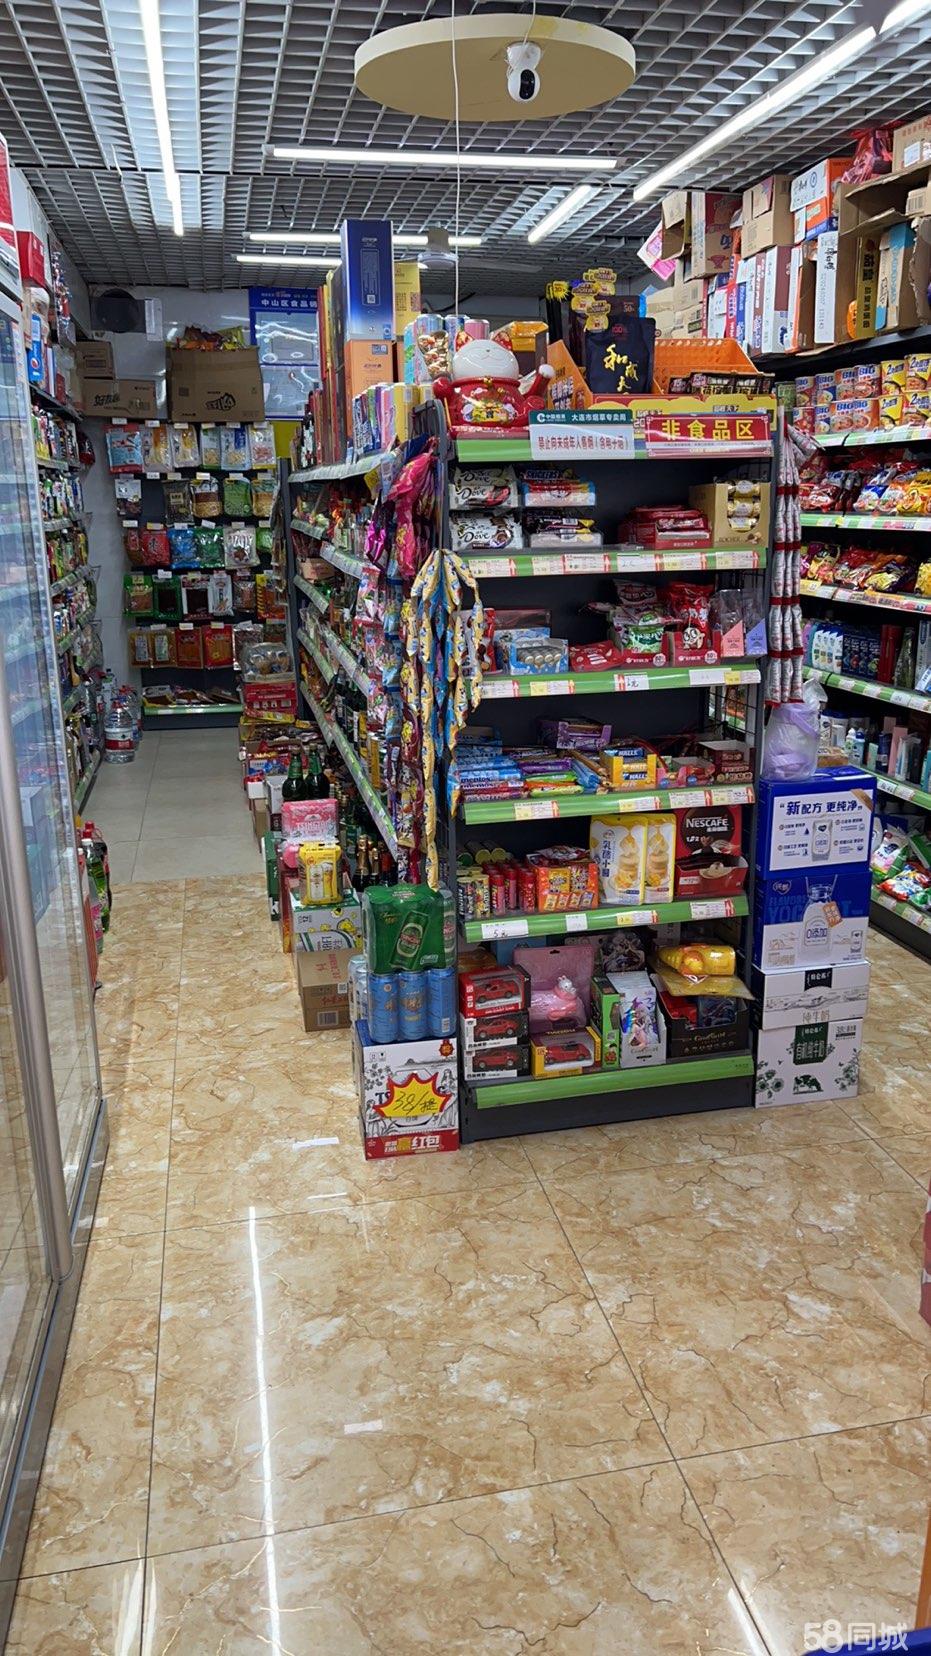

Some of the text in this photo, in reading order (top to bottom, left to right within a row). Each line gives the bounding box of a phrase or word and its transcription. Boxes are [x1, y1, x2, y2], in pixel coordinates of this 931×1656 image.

[661, 419, 755, 441] 非食品区
[458, 487, 487, 500] Dove
[460, 531, 490, 543] Dove
[617, 749, 638, 757] HALLS
[629, 772, 648, 780] HALL
